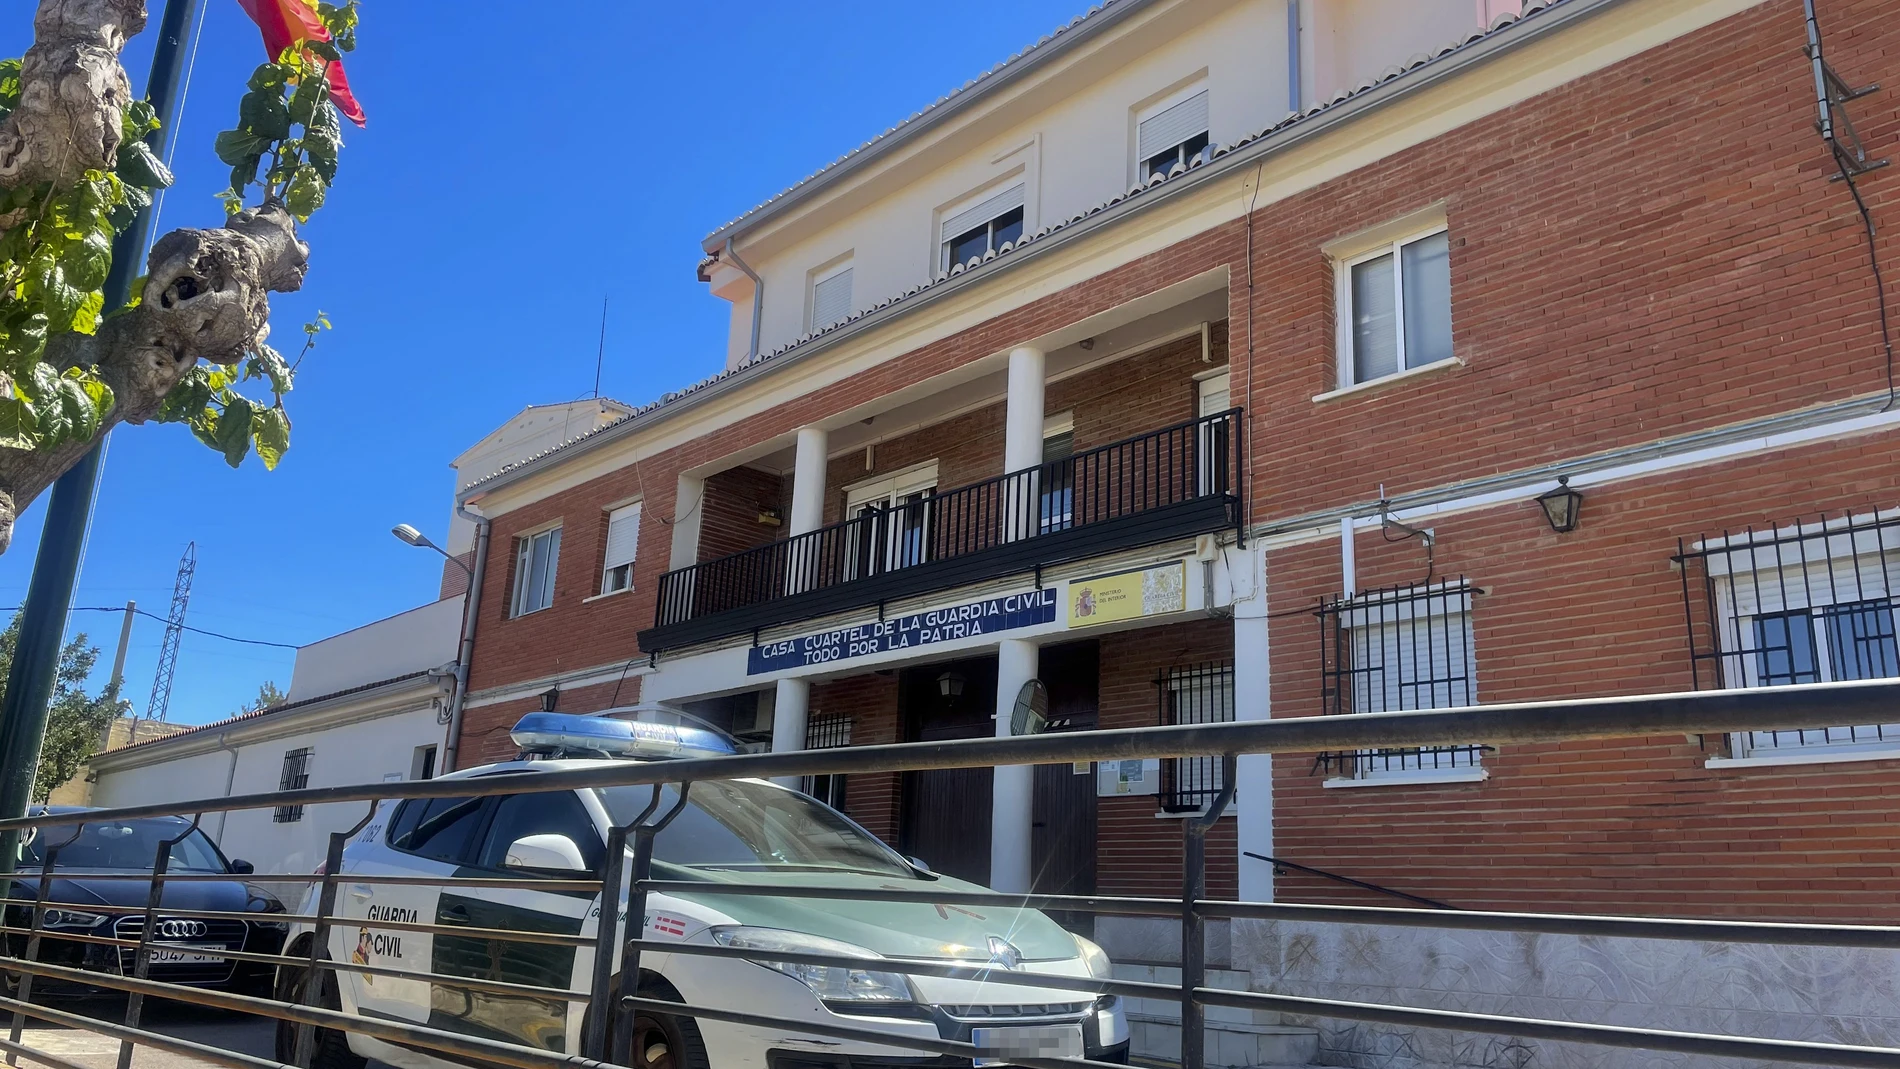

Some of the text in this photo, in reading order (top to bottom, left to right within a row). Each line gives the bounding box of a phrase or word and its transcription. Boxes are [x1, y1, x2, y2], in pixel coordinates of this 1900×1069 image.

[762, 591, 1054, 659] CASA CUARTEL DE LA GUARDIA CIVIL
[804, 620, 982, 665] TODO POR LA PATRIA
[367, 904, 418, 924] GUARDIA
[374, 934, 403, 959] CIVIL
